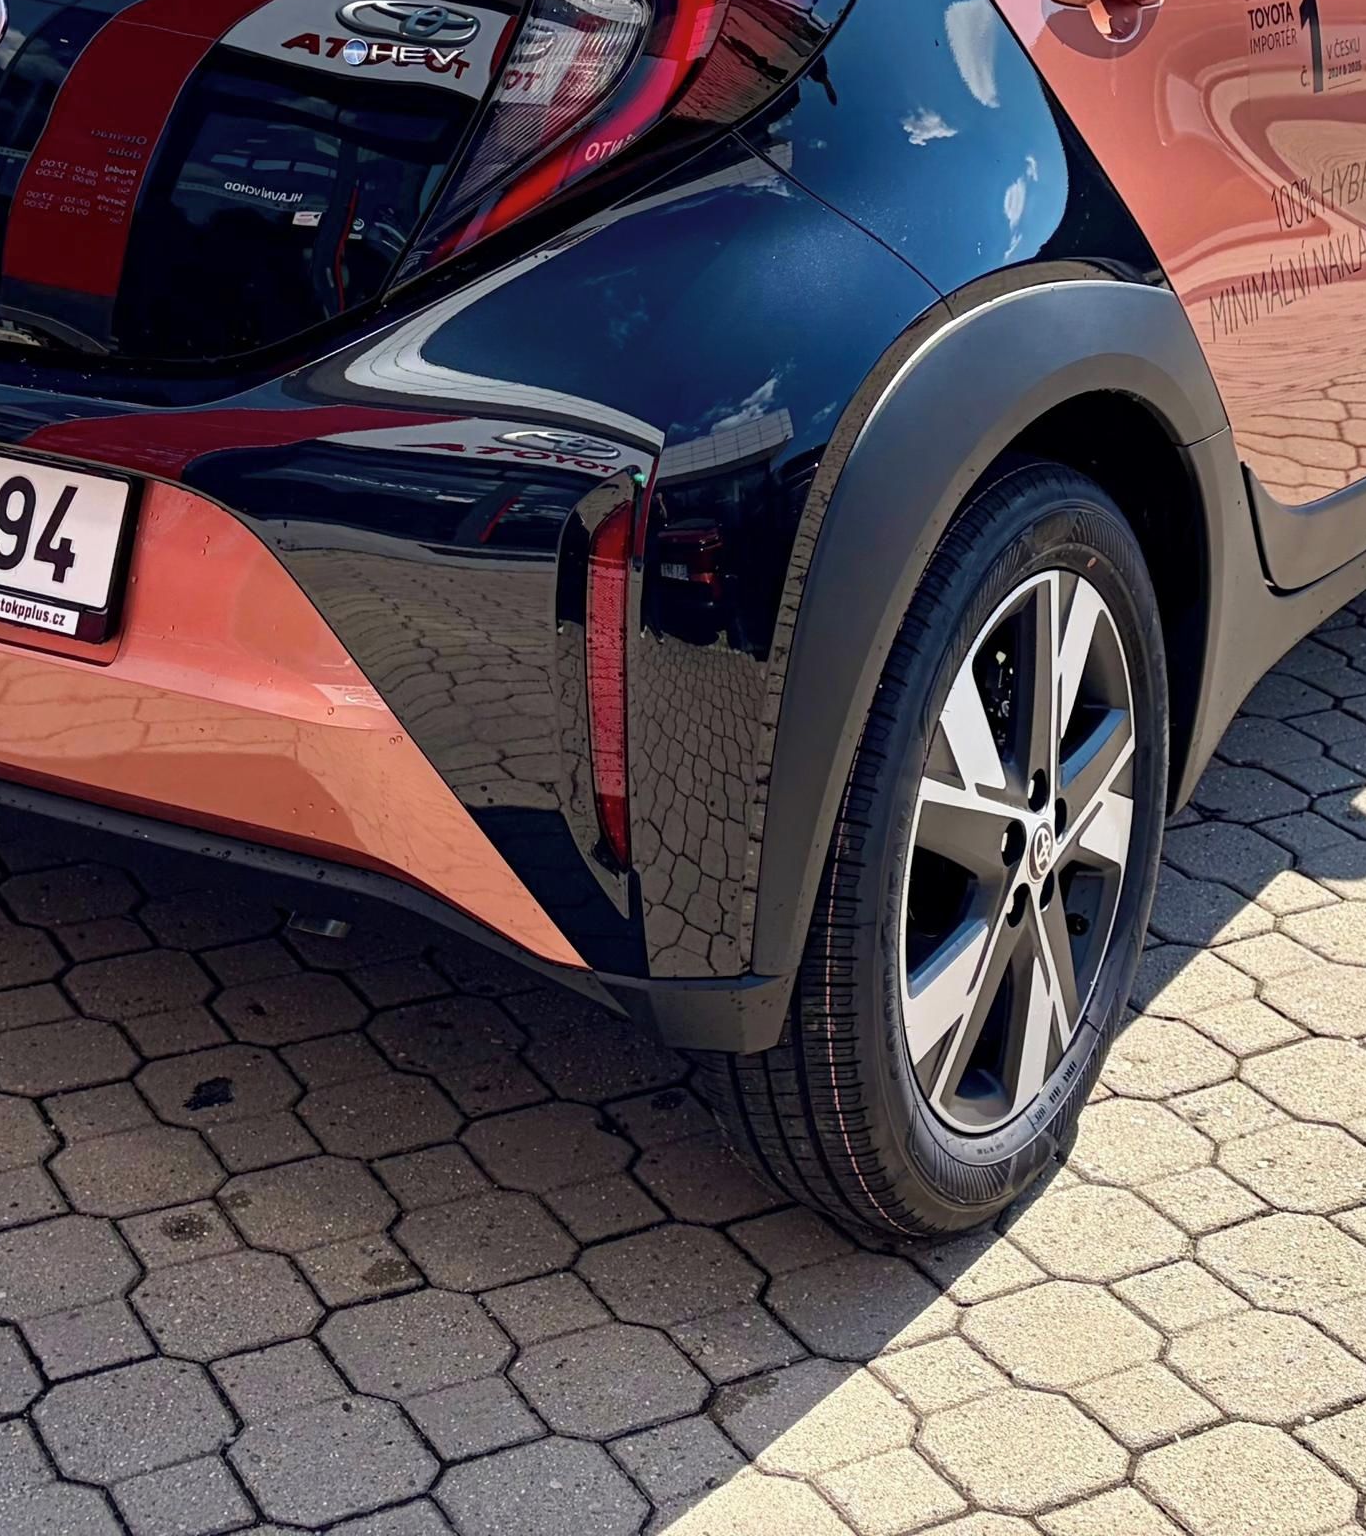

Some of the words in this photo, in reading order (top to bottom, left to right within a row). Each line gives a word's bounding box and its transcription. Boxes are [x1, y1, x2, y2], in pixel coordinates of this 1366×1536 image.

[1247, 1, 1294, 31] TOYOTA
[371, 44, 465, 65] HEV
[1250, 24, 1297, 55] IMPORTÉR
[1270, 175, 1317, 231] 100%
[1208, 240, 1310, 342] MINIMÁLNÍ
